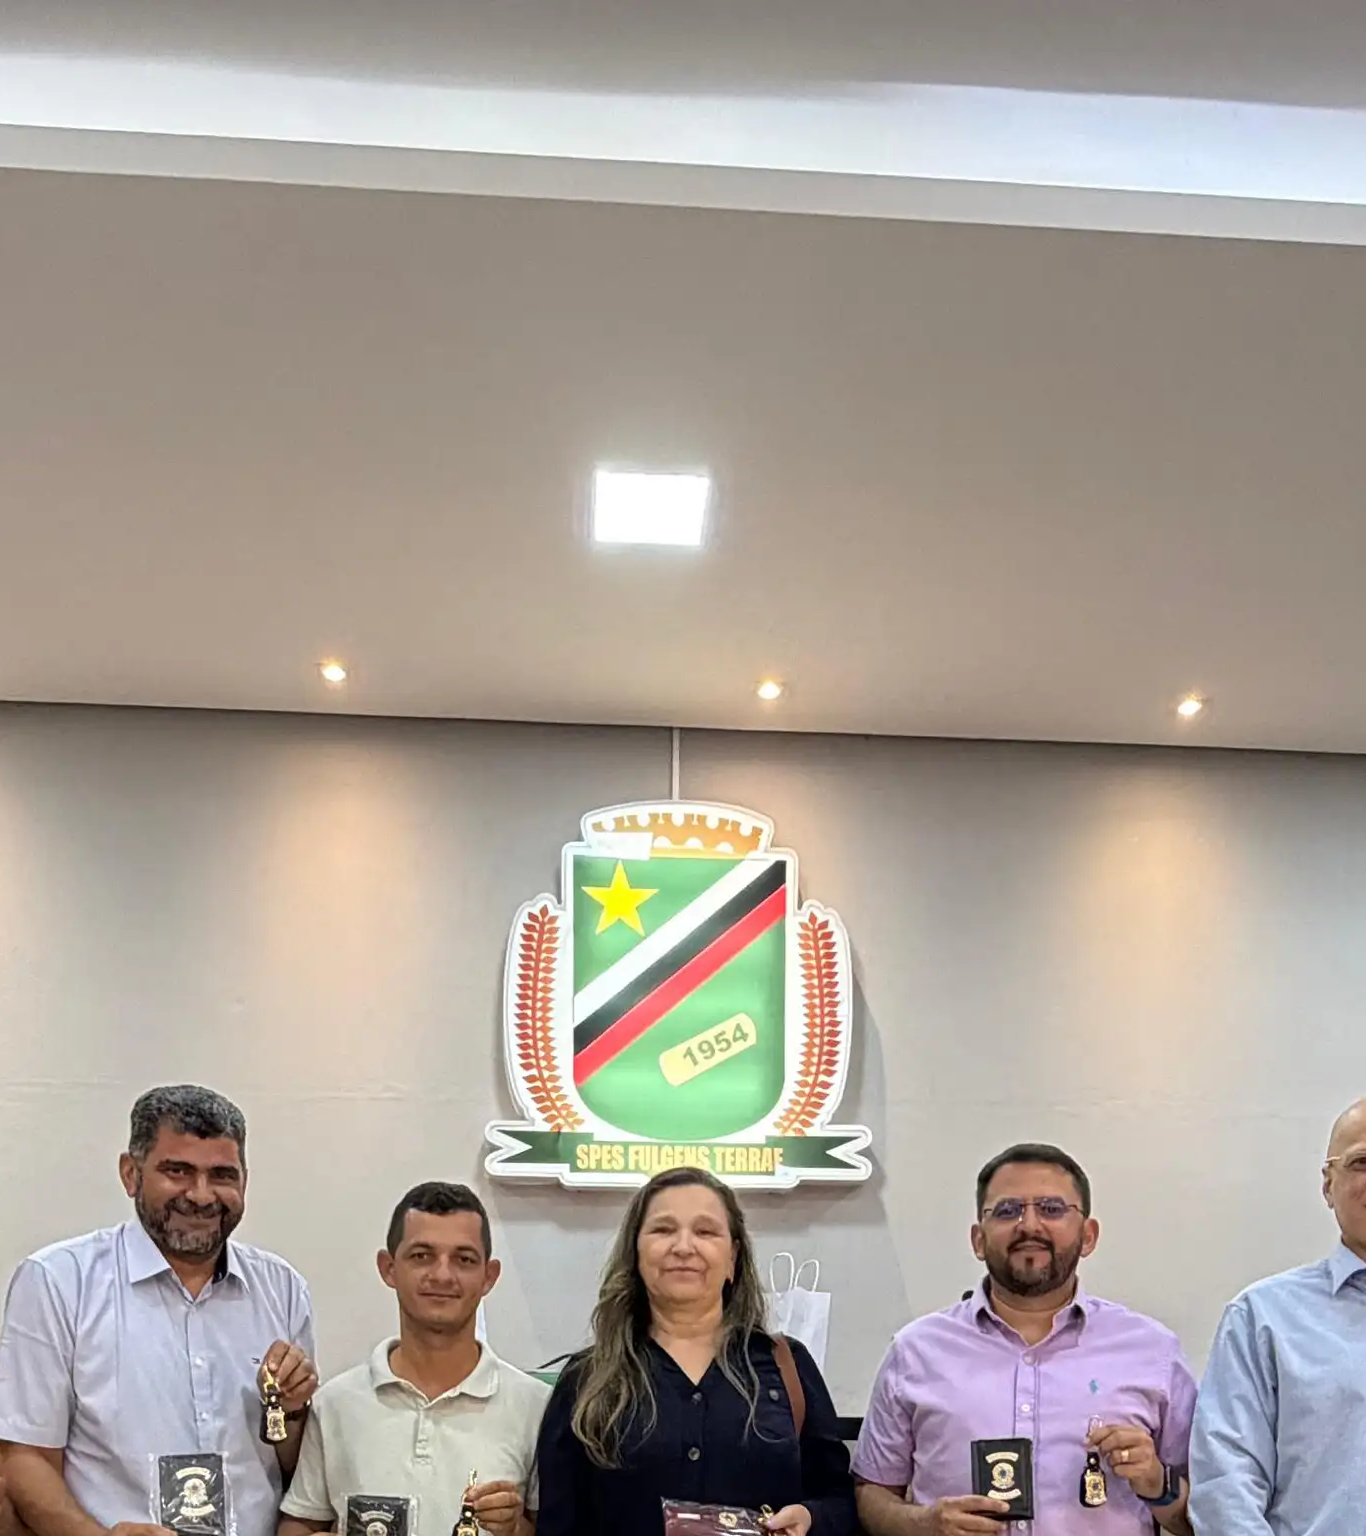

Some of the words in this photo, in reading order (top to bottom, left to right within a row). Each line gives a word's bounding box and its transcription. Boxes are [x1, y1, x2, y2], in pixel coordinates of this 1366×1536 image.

[683, 1023, 749, 1067] 1954
[576, 1144, 625, 1171] SPES
[628, 1145, 711, 1174] FULGENS
